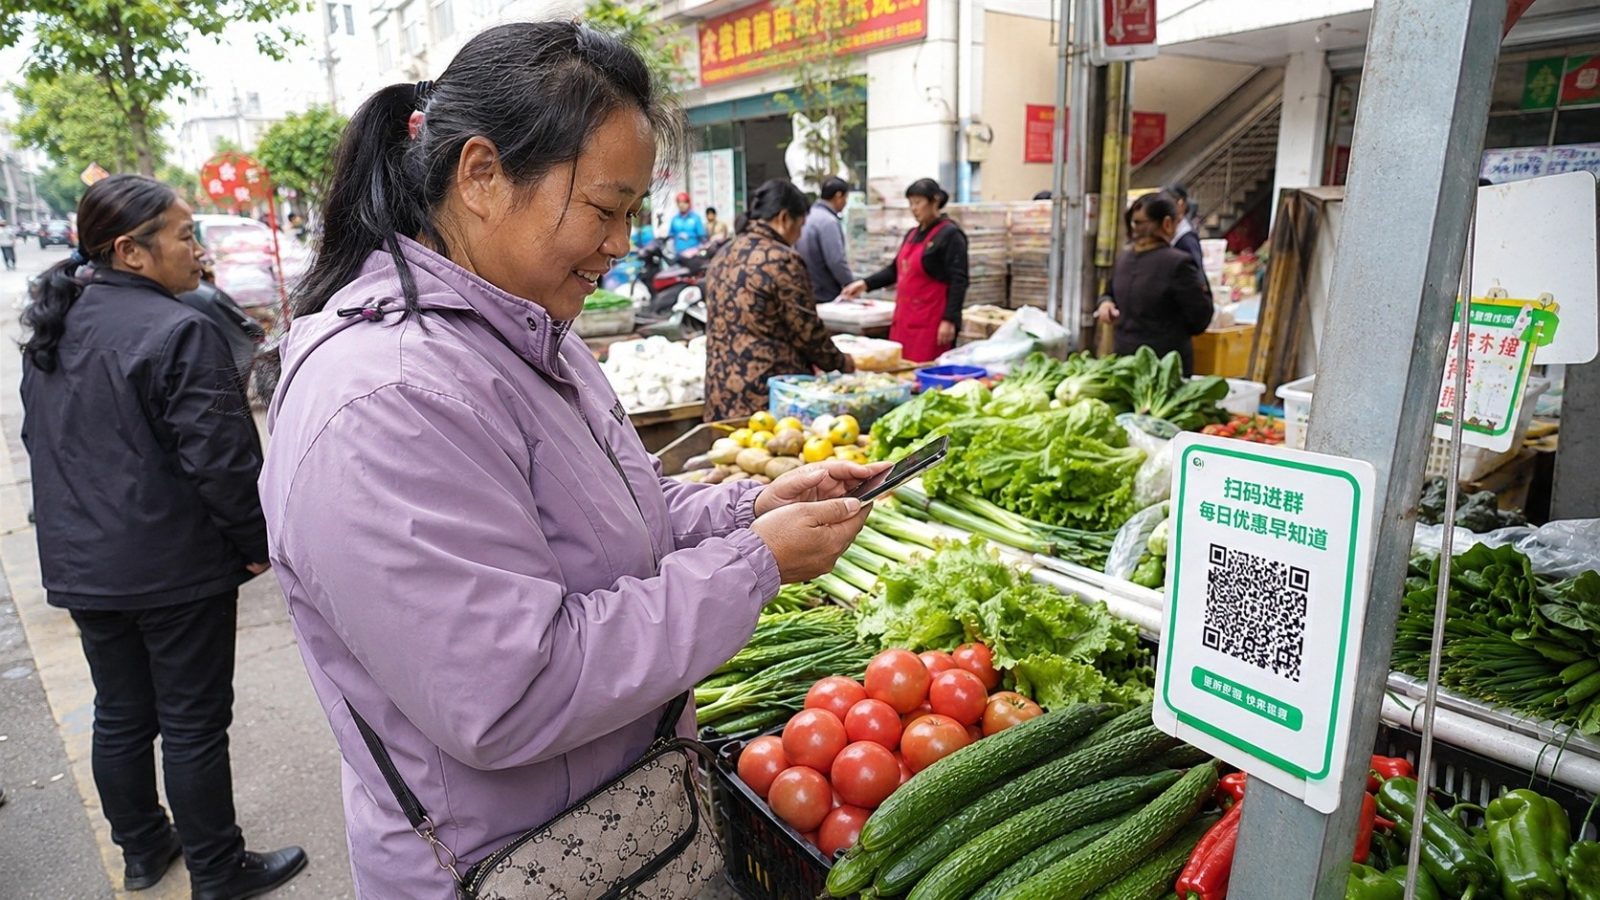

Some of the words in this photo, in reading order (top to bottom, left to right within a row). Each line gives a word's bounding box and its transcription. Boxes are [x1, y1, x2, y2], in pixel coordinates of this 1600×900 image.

[1224, 477, 1304, 515] 扫码进群
[1199, 501, 1328, 550] 每日优惠早知道
